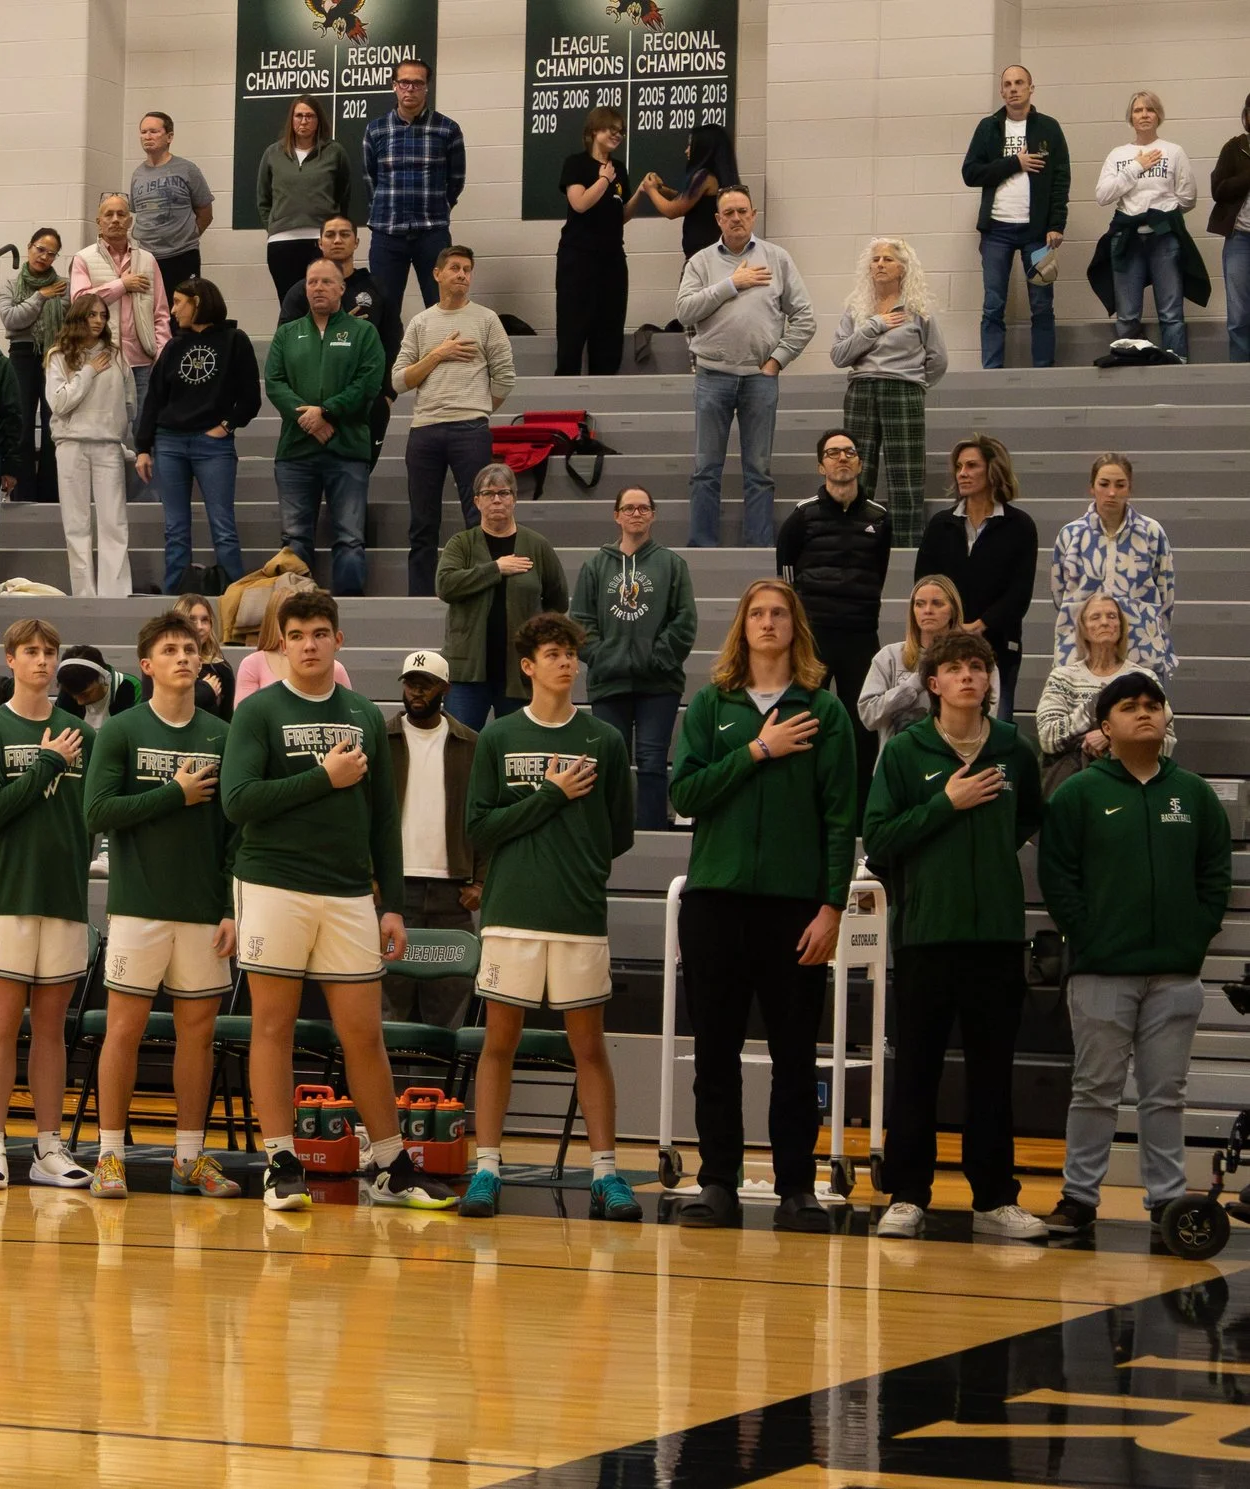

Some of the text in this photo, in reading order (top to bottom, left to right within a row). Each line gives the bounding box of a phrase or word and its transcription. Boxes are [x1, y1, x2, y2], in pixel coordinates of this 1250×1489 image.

[551, 35, 610, 56] LEAGUE
[643, 30, 721, 52] REGIONAL
[260, 49, 316, 70] LEAGUE
[348, 44, 422, 66] REGIONAL
[636, 51, 726, 74] CHAMPIONS
[341, 66, 393, 88] CHAMP
[535, 55, 624, 78] CHAMPIONS
[246, 69, 330, 91] CHAMPIONS
[532, 87, 622, 111] 2005 2006 2018
[638, 83, 728, 107] 2005 2006 2013
[342, 99, 367, 119] 2012
[637, 107, 727, 130] 2018 2019 2021
[531, 113, 558, 134] 2019
[1147, 166, 1168, 179] MOM
[634, 570, 654, 593] TATE
[610, 603, 649, 621] FIREBIRDS
[283, 727, 323, 747] FREE
[137, 752, 175, 772] FREE
[504, 757, 545, 777] FREE
[1160, 813, 1192, 823] BASKETBALL
[403, 944, 466, 962] REBIRDS
[313, 1153, 327, 1163] 02
